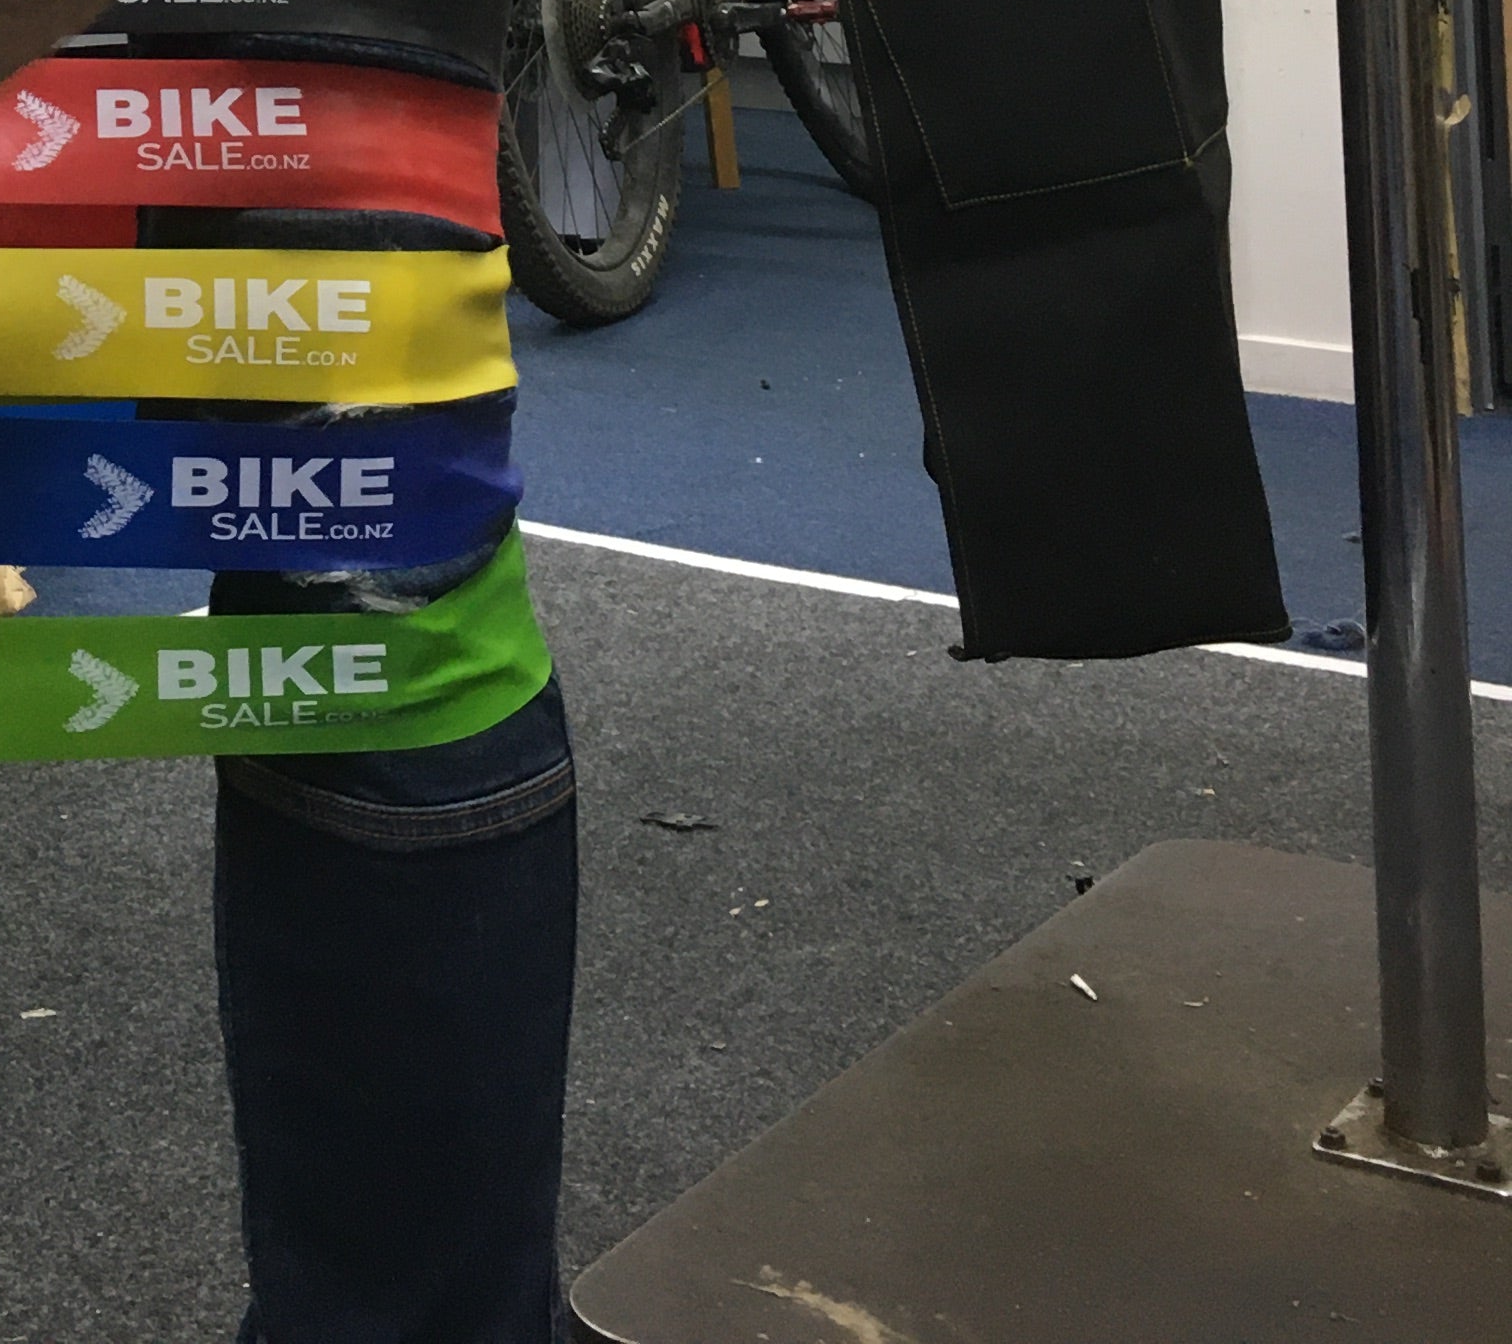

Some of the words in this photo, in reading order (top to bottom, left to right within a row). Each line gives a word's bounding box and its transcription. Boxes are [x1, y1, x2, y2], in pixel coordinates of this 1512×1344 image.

[96, 87, 308, 139] BIKE
[136, 143, 310, 171] SALE.CO.NZ
[630, 193, 670, 277] MAXXIS
[144, 277, 373, 333] BIKE
[171, 457, 396, 508] BIKE
[209, 512, 394, 542] SALE.CO.NZ
[156, 643, 389, 700] BIKE
